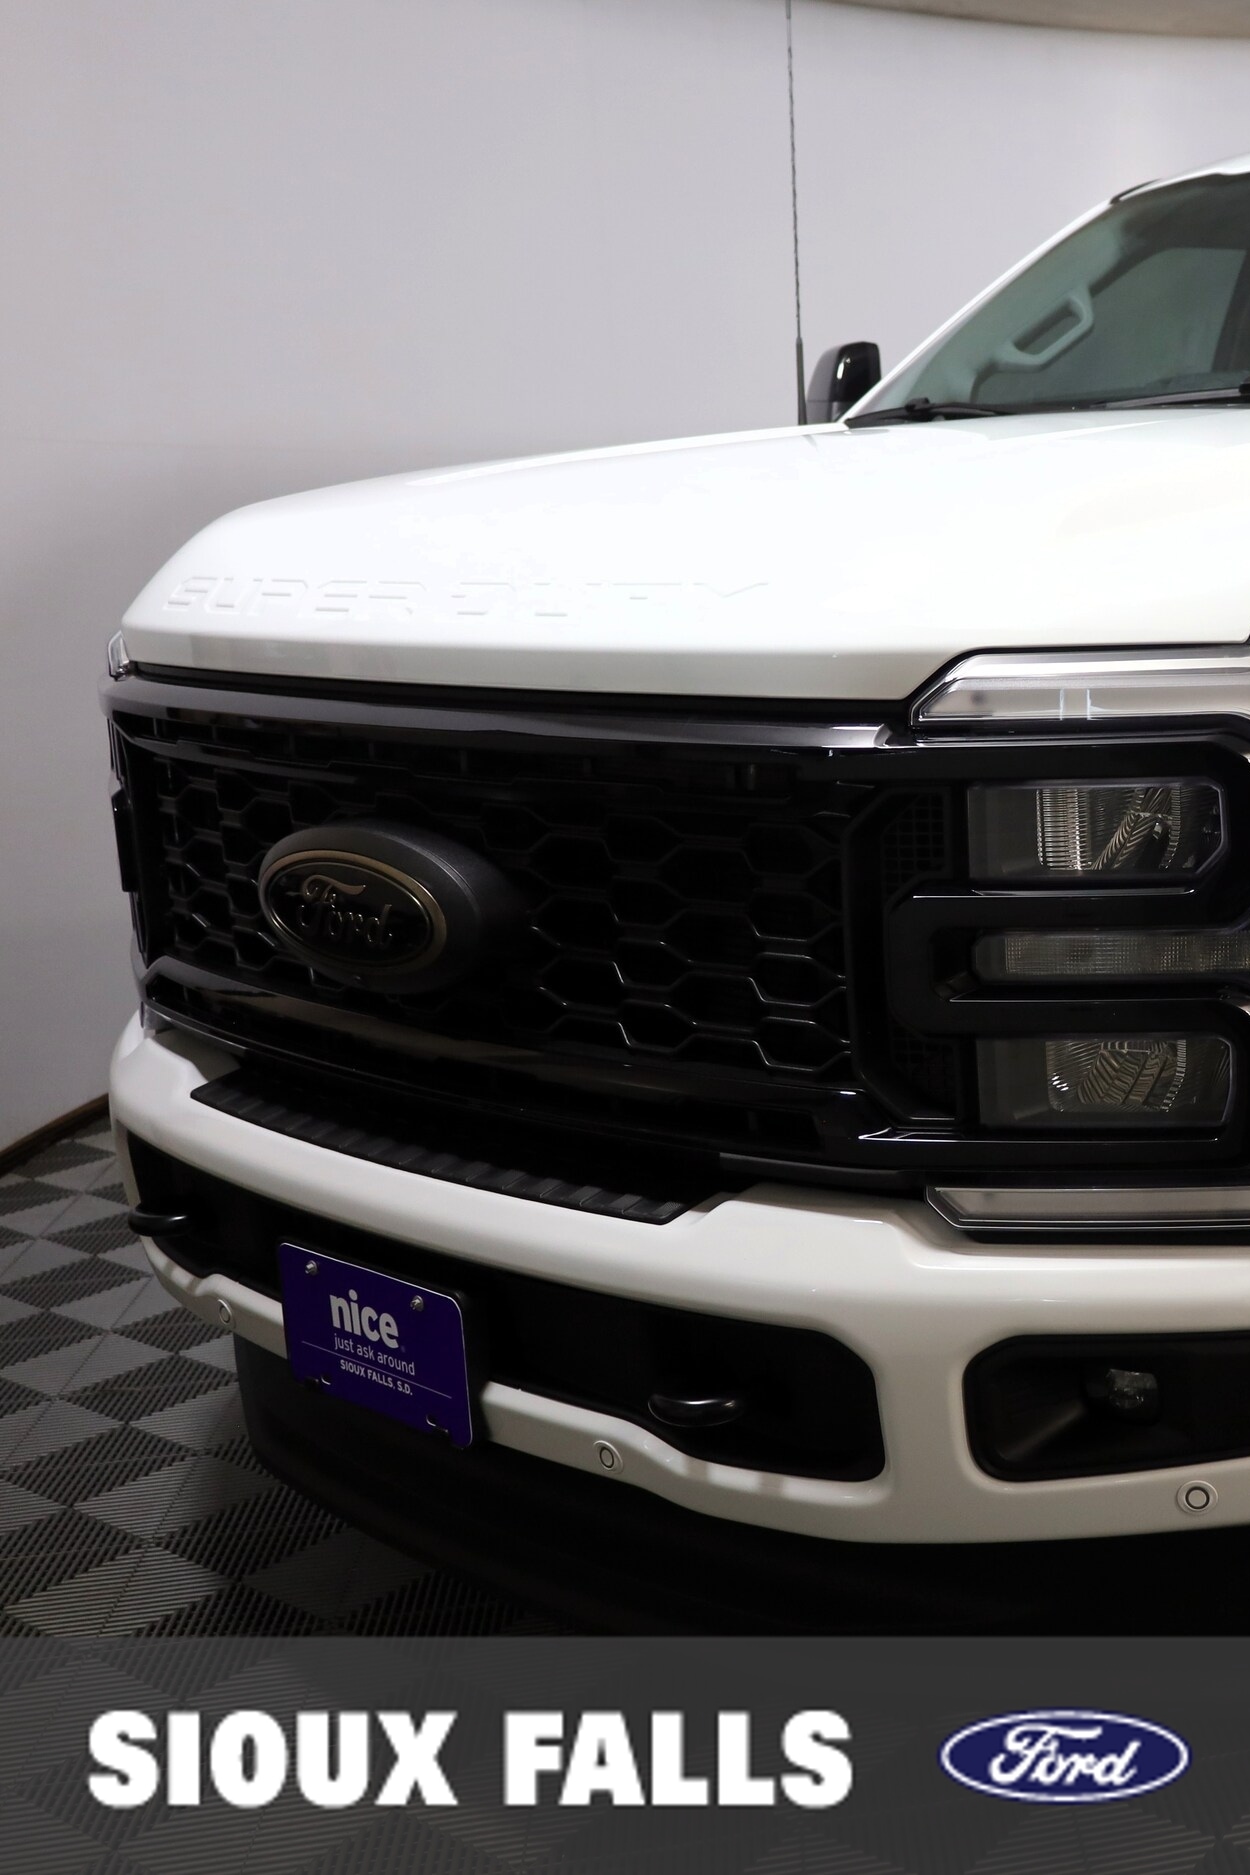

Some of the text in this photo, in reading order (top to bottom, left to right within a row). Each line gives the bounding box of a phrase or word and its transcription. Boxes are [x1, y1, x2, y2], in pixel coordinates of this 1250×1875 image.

[162, 576, 427, 617] SUPER
[299, 873, 394, 949] Ford
[329, 1289, 399, 1349] nice
[334, 1333, 416, 1376] just ask around
[340, 1359, 366, 1378] SIOUX
[397, 1381, 413, 1396] S.D.
